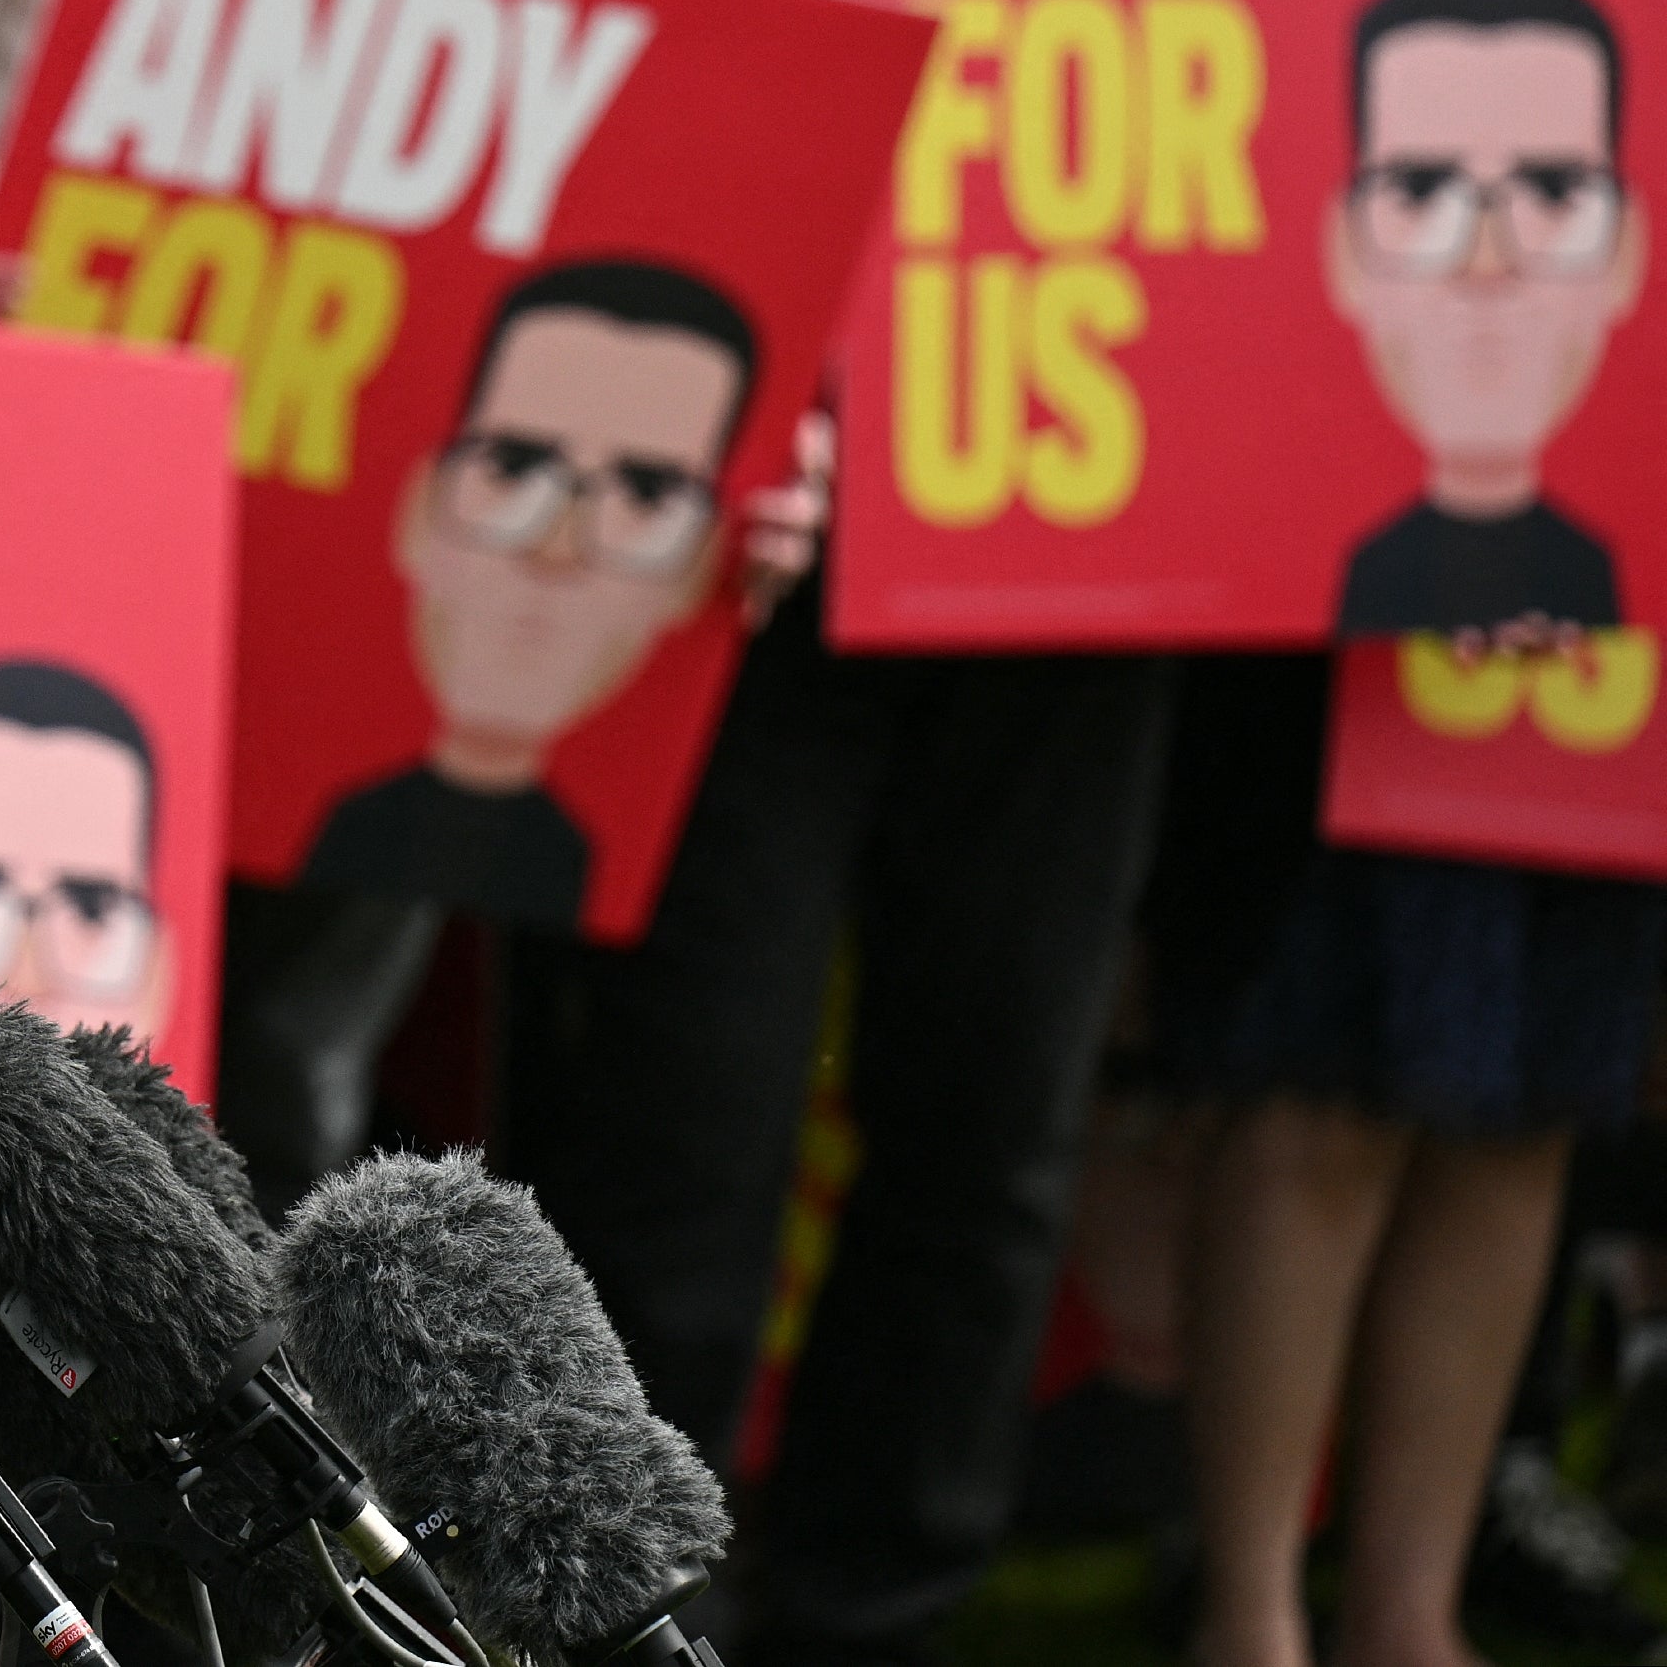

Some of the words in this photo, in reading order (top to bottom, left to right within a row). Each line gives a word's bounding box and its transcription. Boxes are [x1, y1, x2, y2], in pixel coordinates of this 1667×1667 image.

[893, 250, 1147, 527] US
[22, 1323, 67, 1377] Rycote
[38, 1620, 57, 1643] sky
[52, 1639, 69, 1656] 0207
